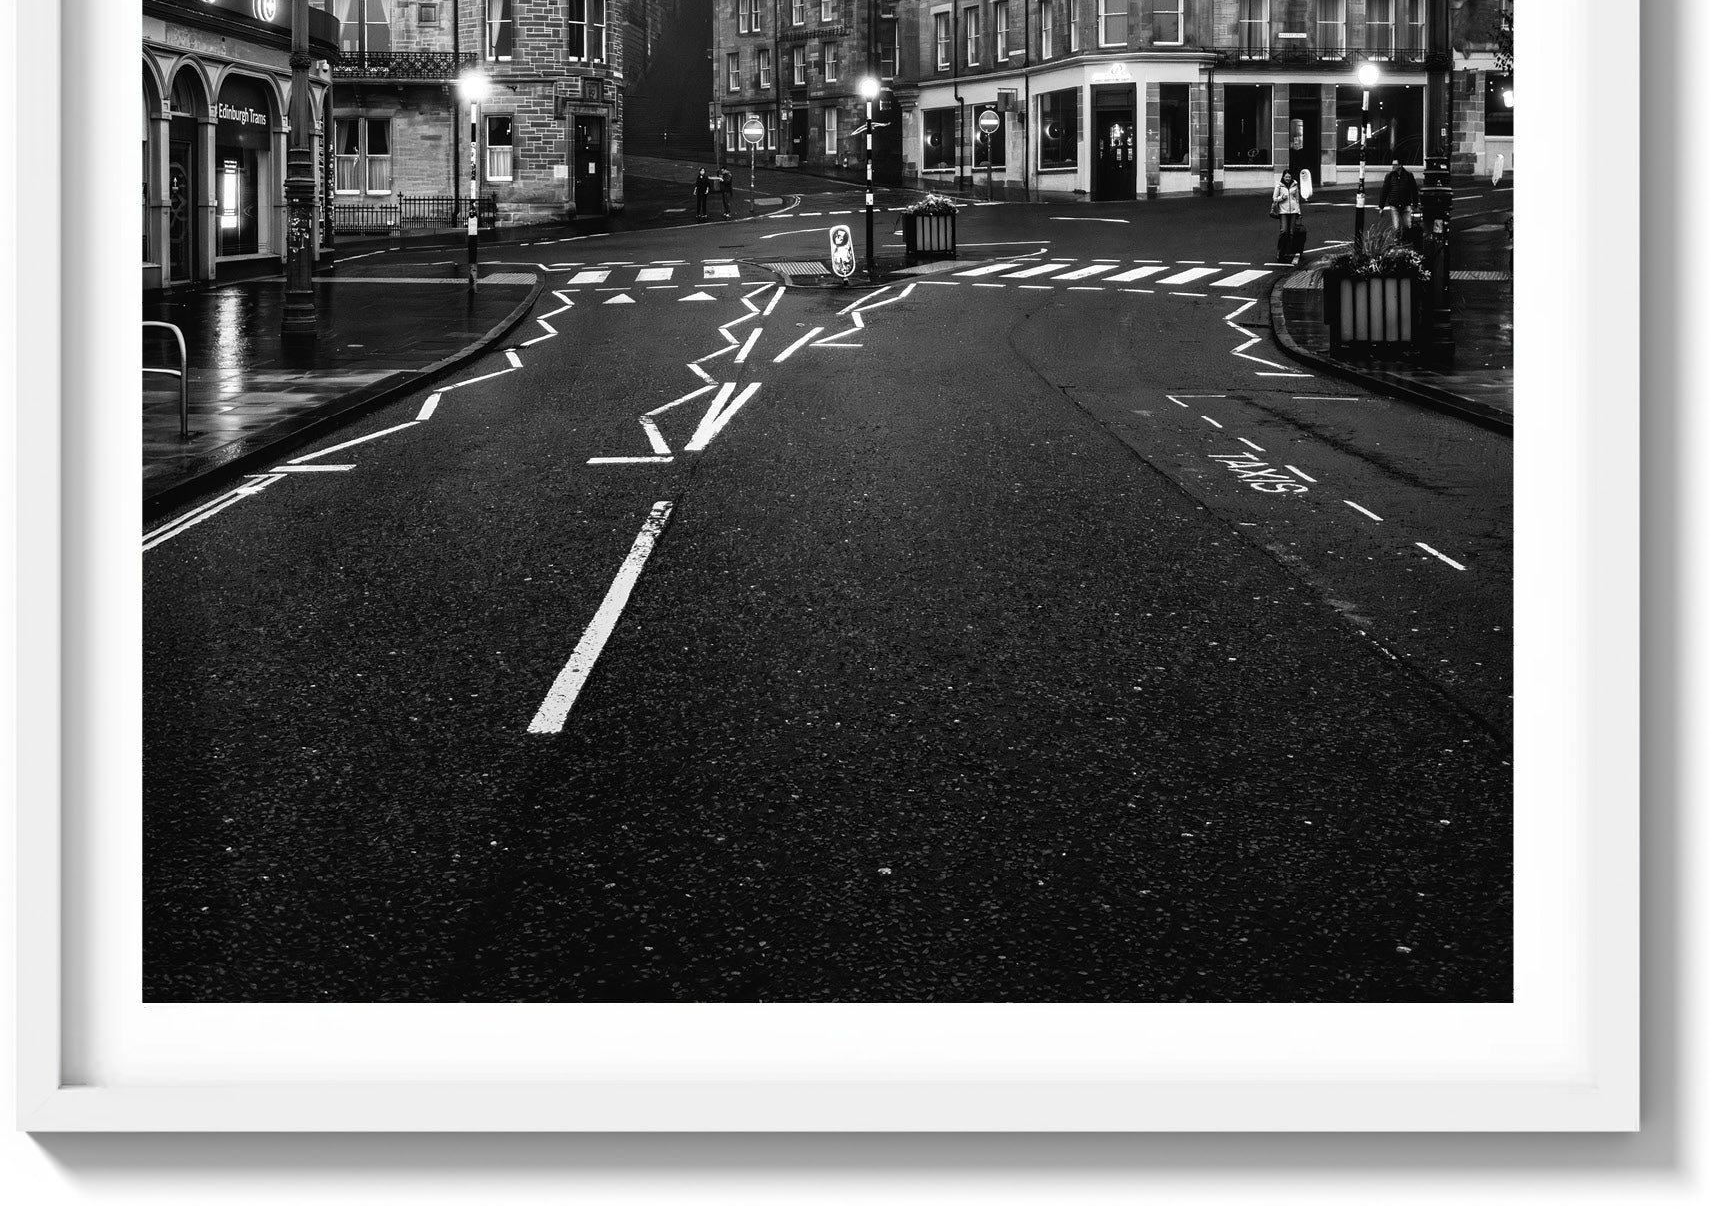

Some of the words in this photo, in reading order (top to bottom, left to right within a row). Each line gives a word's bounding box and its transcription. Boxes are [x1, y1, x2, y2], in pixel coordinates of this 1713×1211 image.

[218, 102, 249, 125] Edinburgh
[248, 108, 267, 126] Trams
[1207, 451, 1309, 493] TAXIS
